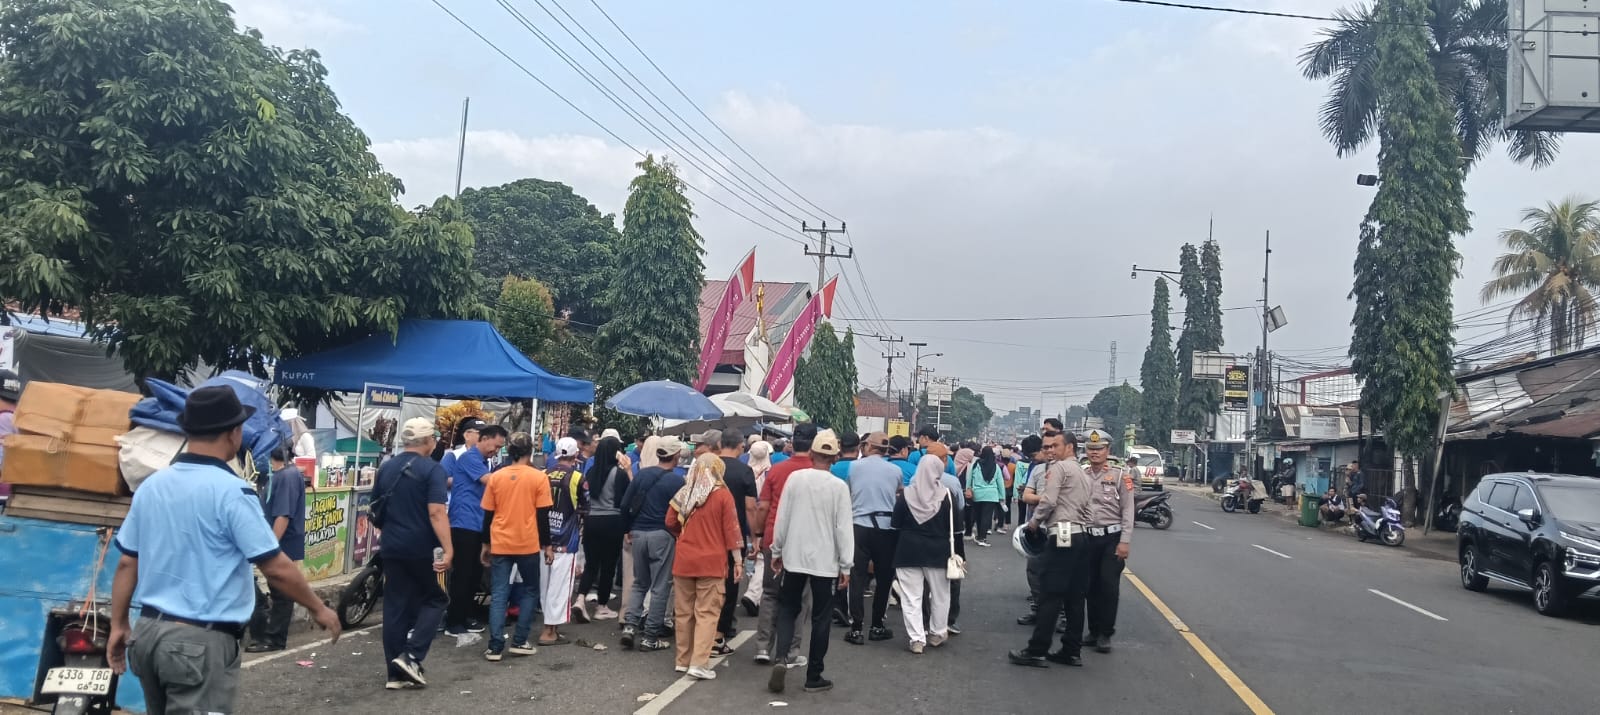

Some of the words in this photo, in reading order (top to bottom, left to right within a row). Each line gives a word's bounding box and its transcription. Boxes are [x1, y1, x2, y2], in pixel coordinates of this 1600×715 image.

[281, 371, 316, 380] KUPAT
[1145, 466, 1157, 477] 09
[312, 496, 336, 514] JAGUNG
[324, 510, 343, 528] TARIK
[47, 670, 54, 680] Z
[58, 669, 84, 680] 4336
[91, 670, 110, 681] TBG
